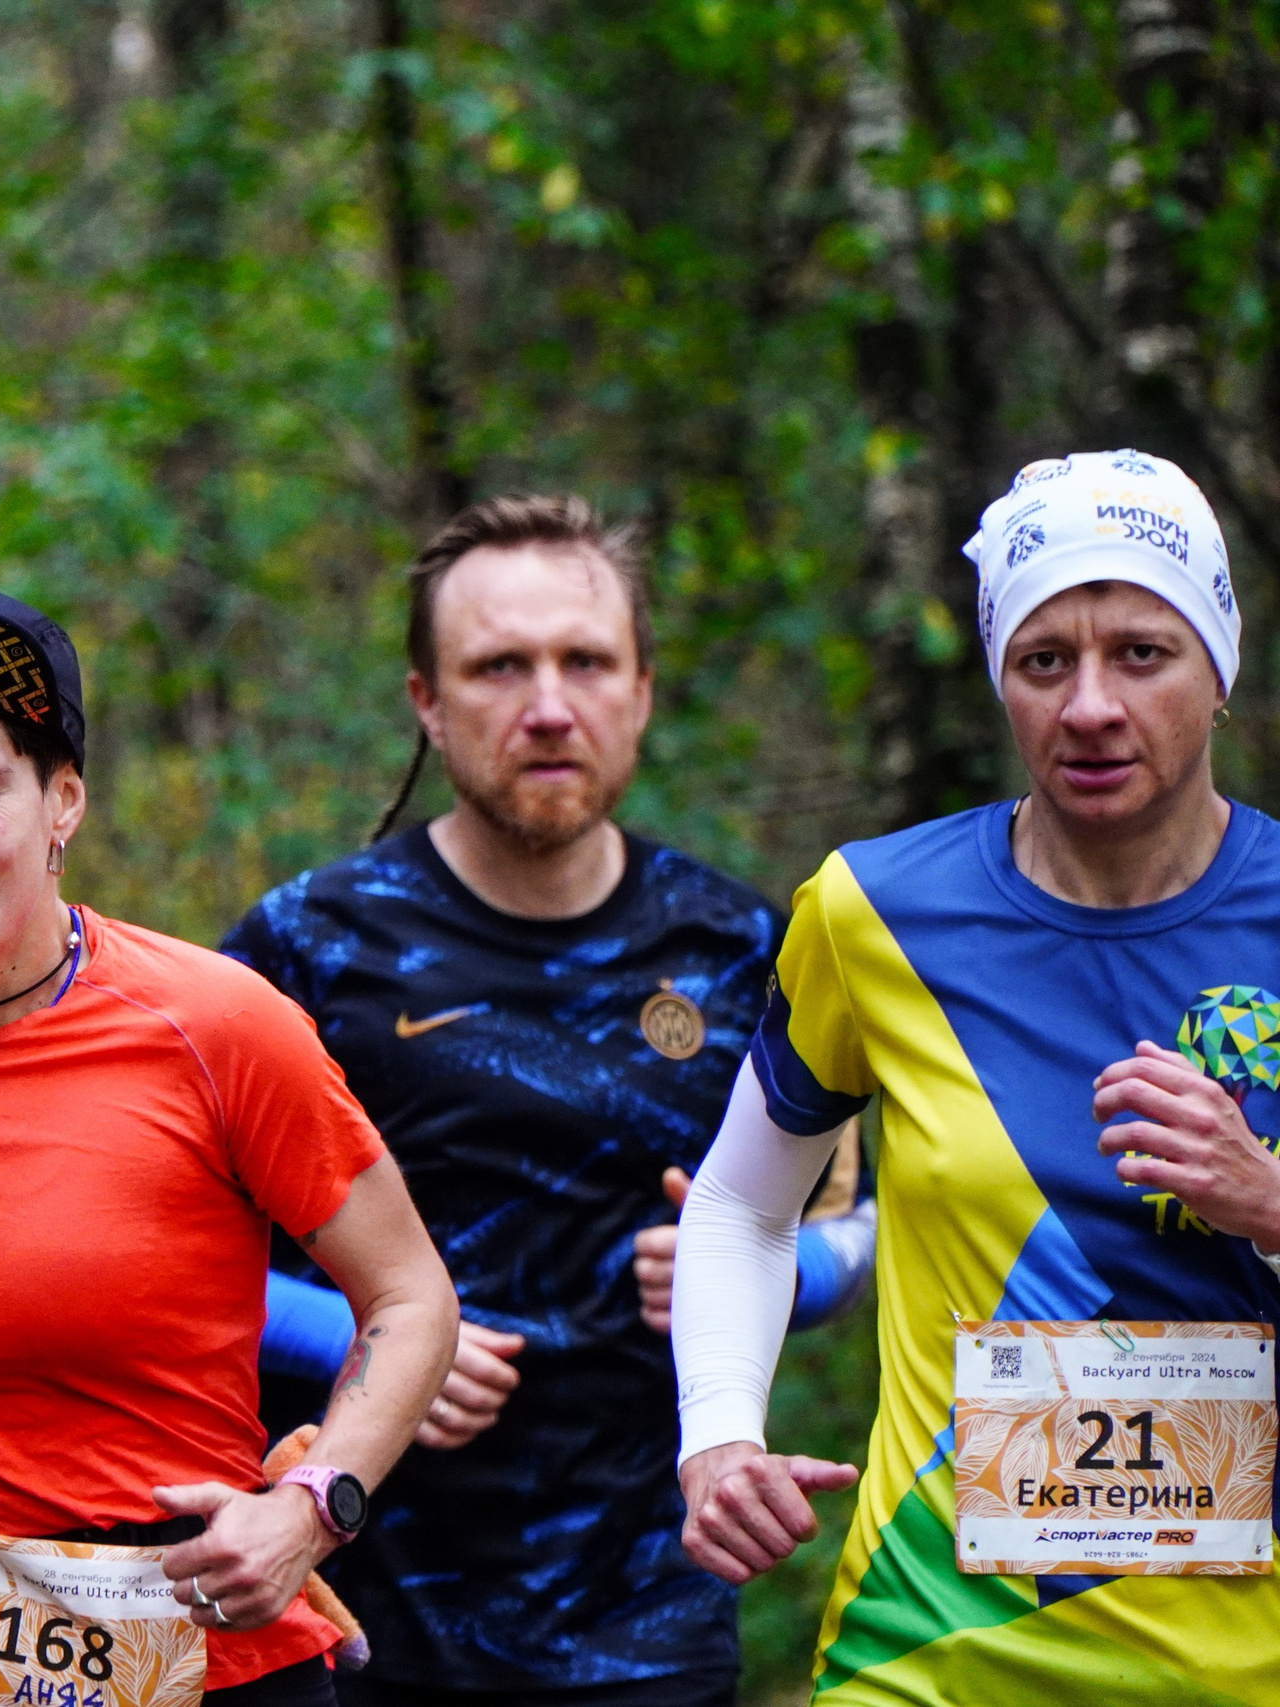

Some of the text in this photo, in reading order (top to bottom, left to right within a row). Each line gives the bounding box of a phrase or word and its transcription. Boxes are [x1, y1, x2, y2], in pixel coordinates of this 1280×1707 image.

[1096, 505, 1189, 546] НАЦИИ
[1123, 522, 1188, 566] КРОСС
[1113, 1352, 1216, 1363] 28 сентября 2024
[1082, 1366, 1256, 1380] Backyard Ultra Moscow
[1075, 1410, 1163, 1470] 21
[1018, 1478, 1214, 1515] Екатерина
[1156, 1532, 1195, 1544] PRO
[22, 1573, 175, 1600] kyard Ultra Mosco
[44, 1569, 57, 1579] 28
[118, 1575, 143, 1585] 2024
